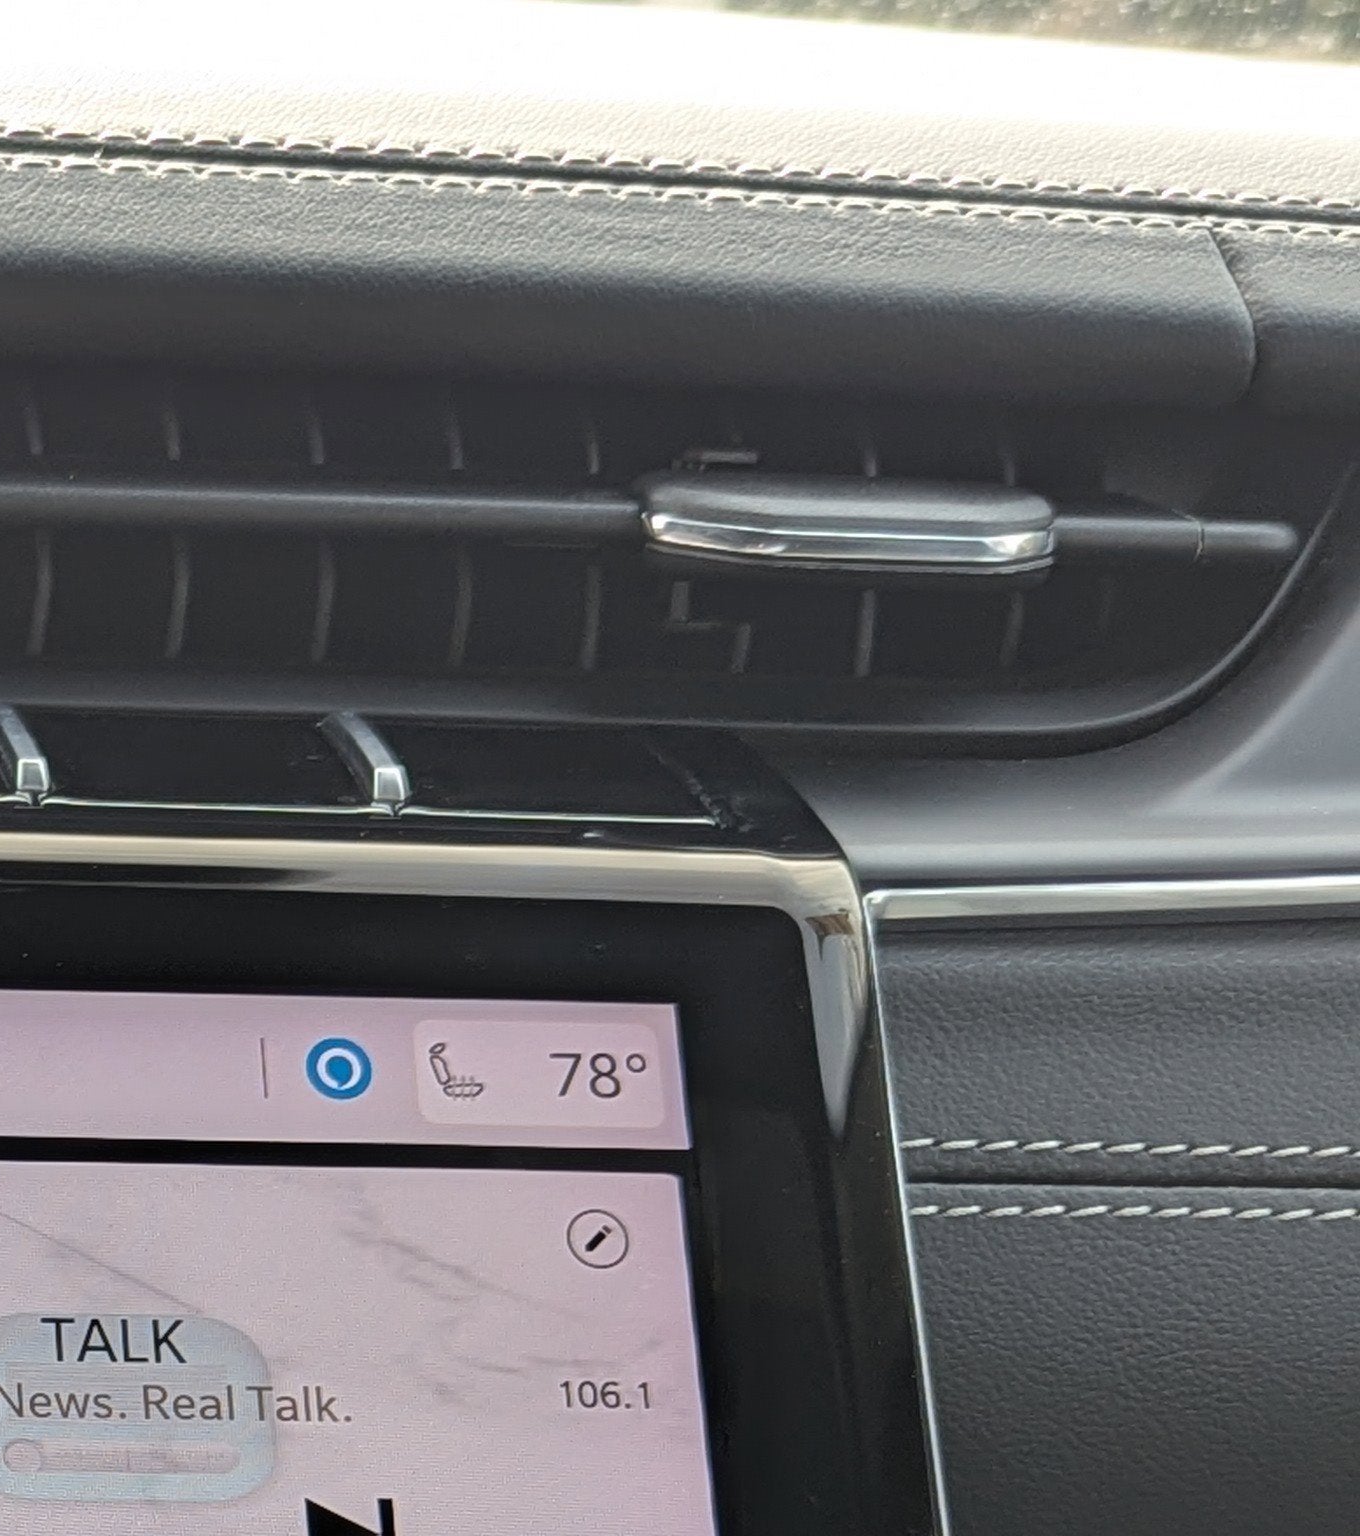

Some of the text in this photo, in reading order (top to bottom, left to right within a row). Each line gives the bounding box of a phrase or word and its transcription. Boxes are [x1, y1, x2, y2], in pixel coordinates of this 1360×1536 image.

[548, 1051, 648, 1099] 78°
[41, 1318, 187, 1364] TALK
[143, 1385, 235, 1421] Real
[246, 1386, 353, 1424] Talk.
[560, 1380, 651, 1410] 106.1
